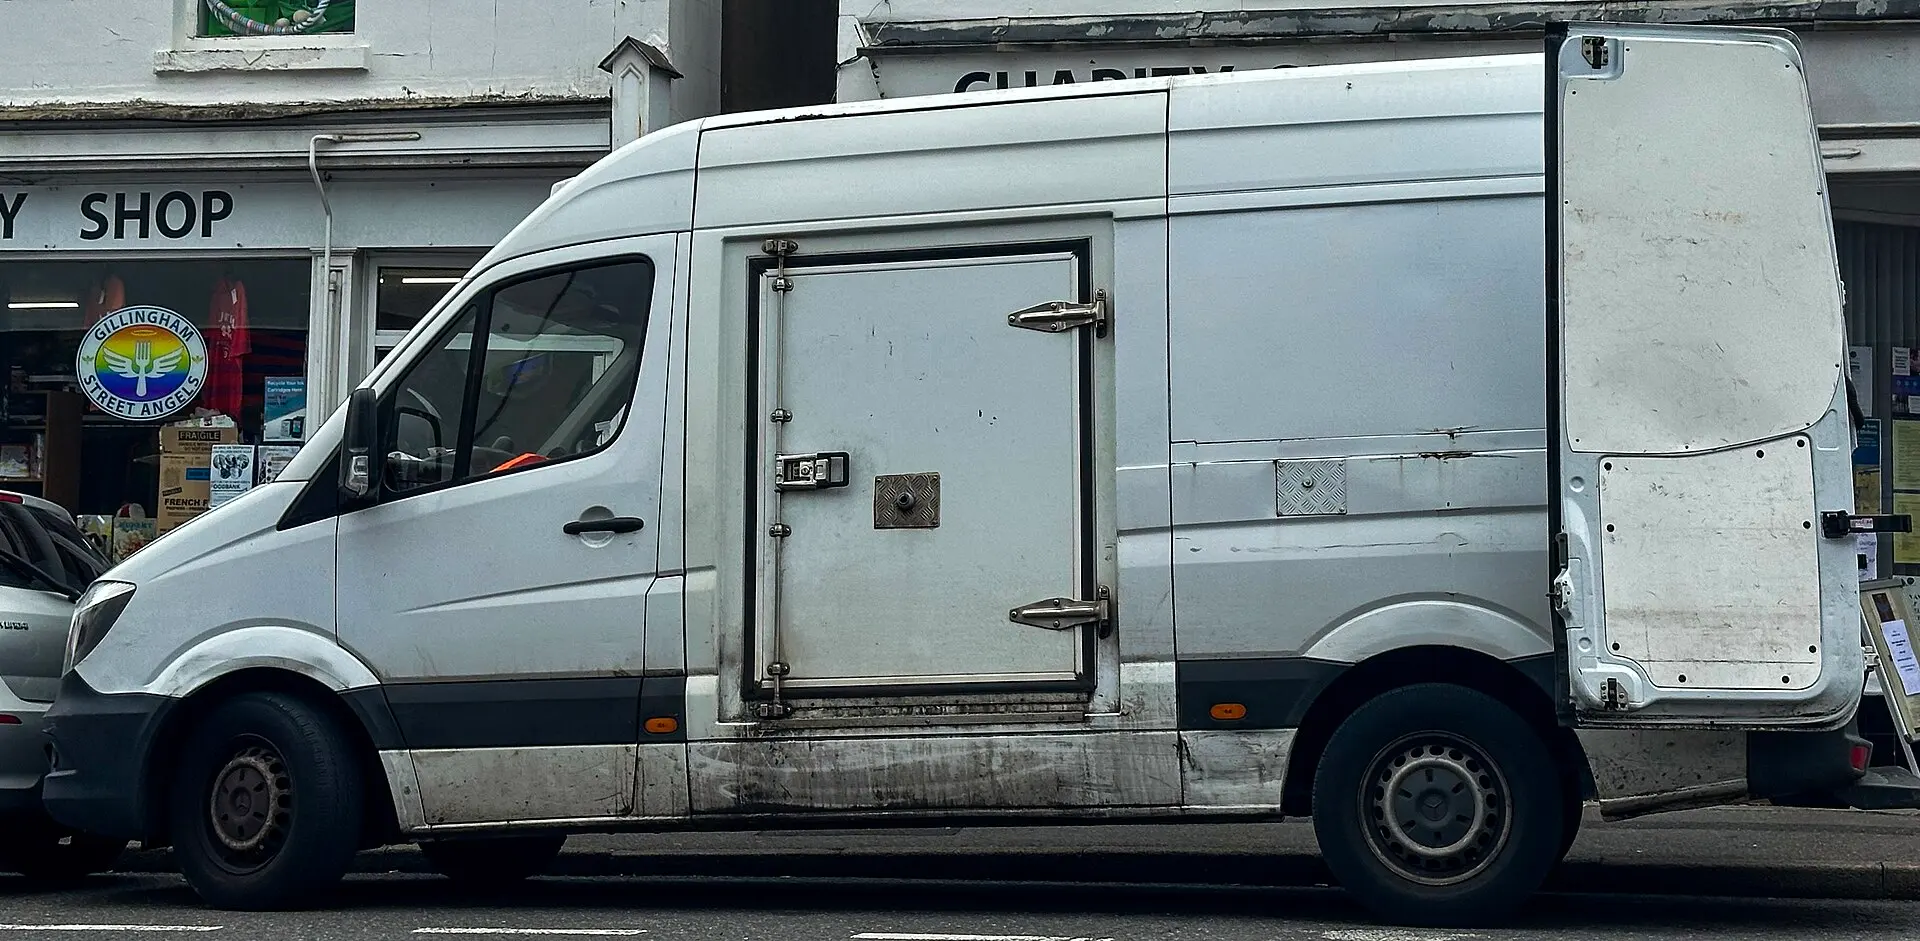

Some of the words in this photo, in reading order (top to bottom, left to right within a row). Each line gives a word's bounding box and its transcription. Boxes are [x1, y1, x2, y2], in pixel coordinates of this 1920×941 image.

[79, 190, 234, 240] SHOP
[94, 310, 195, 342] GILLINGHAM
[84, 375, 136, 415] STREET
[140, 375, 200, 416] ANGELS
[179, 431, 220, 440] FRAGILE
[164, 498, 200, 506] FRENCH
